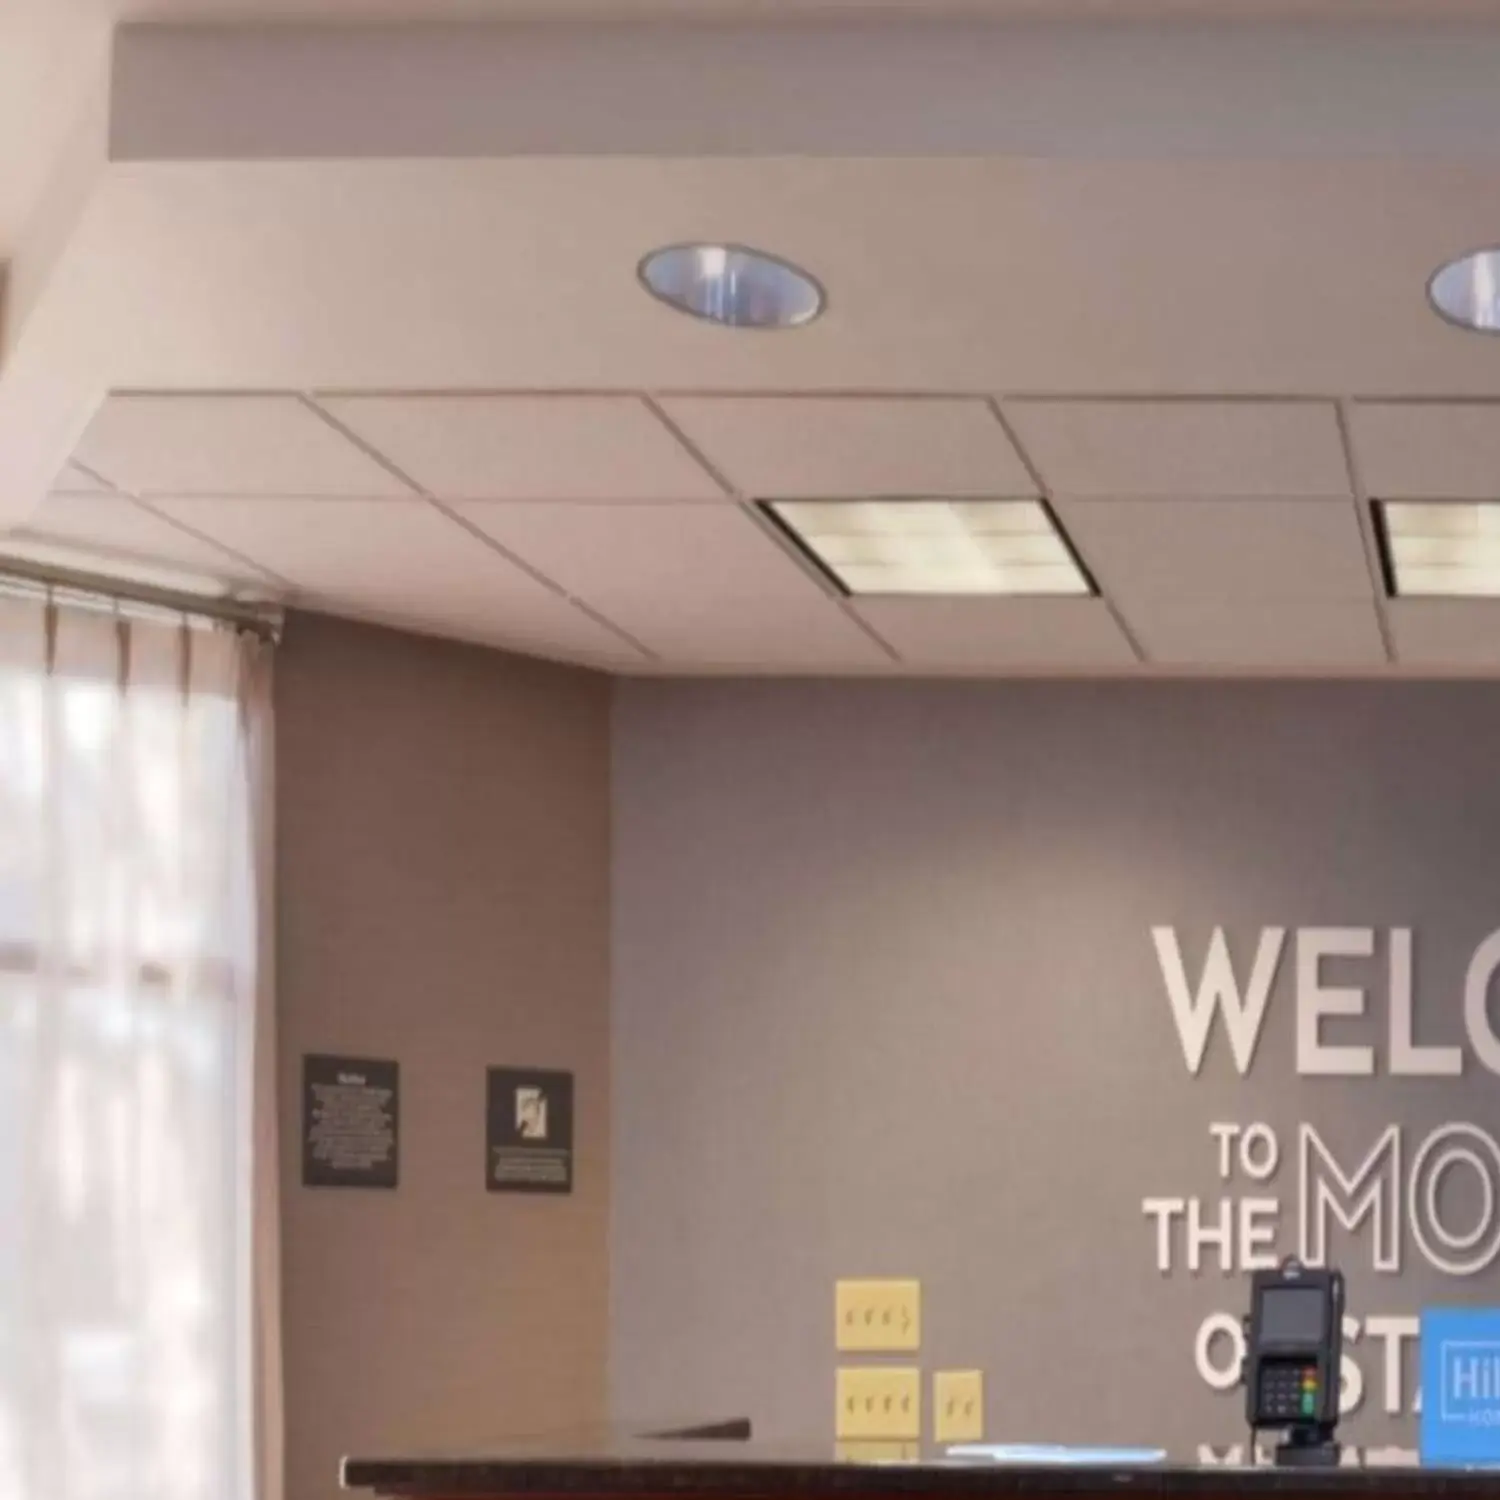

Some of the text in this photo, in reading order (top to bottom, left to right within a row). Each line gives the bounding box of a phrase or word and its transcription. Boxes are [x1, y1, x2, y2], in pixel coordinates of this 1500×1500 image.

[1210, 1122, 1279, 1179] TO
[1143, 1198, 1280, 1271] THE
[1195, 1312, 1247, 1390] O
